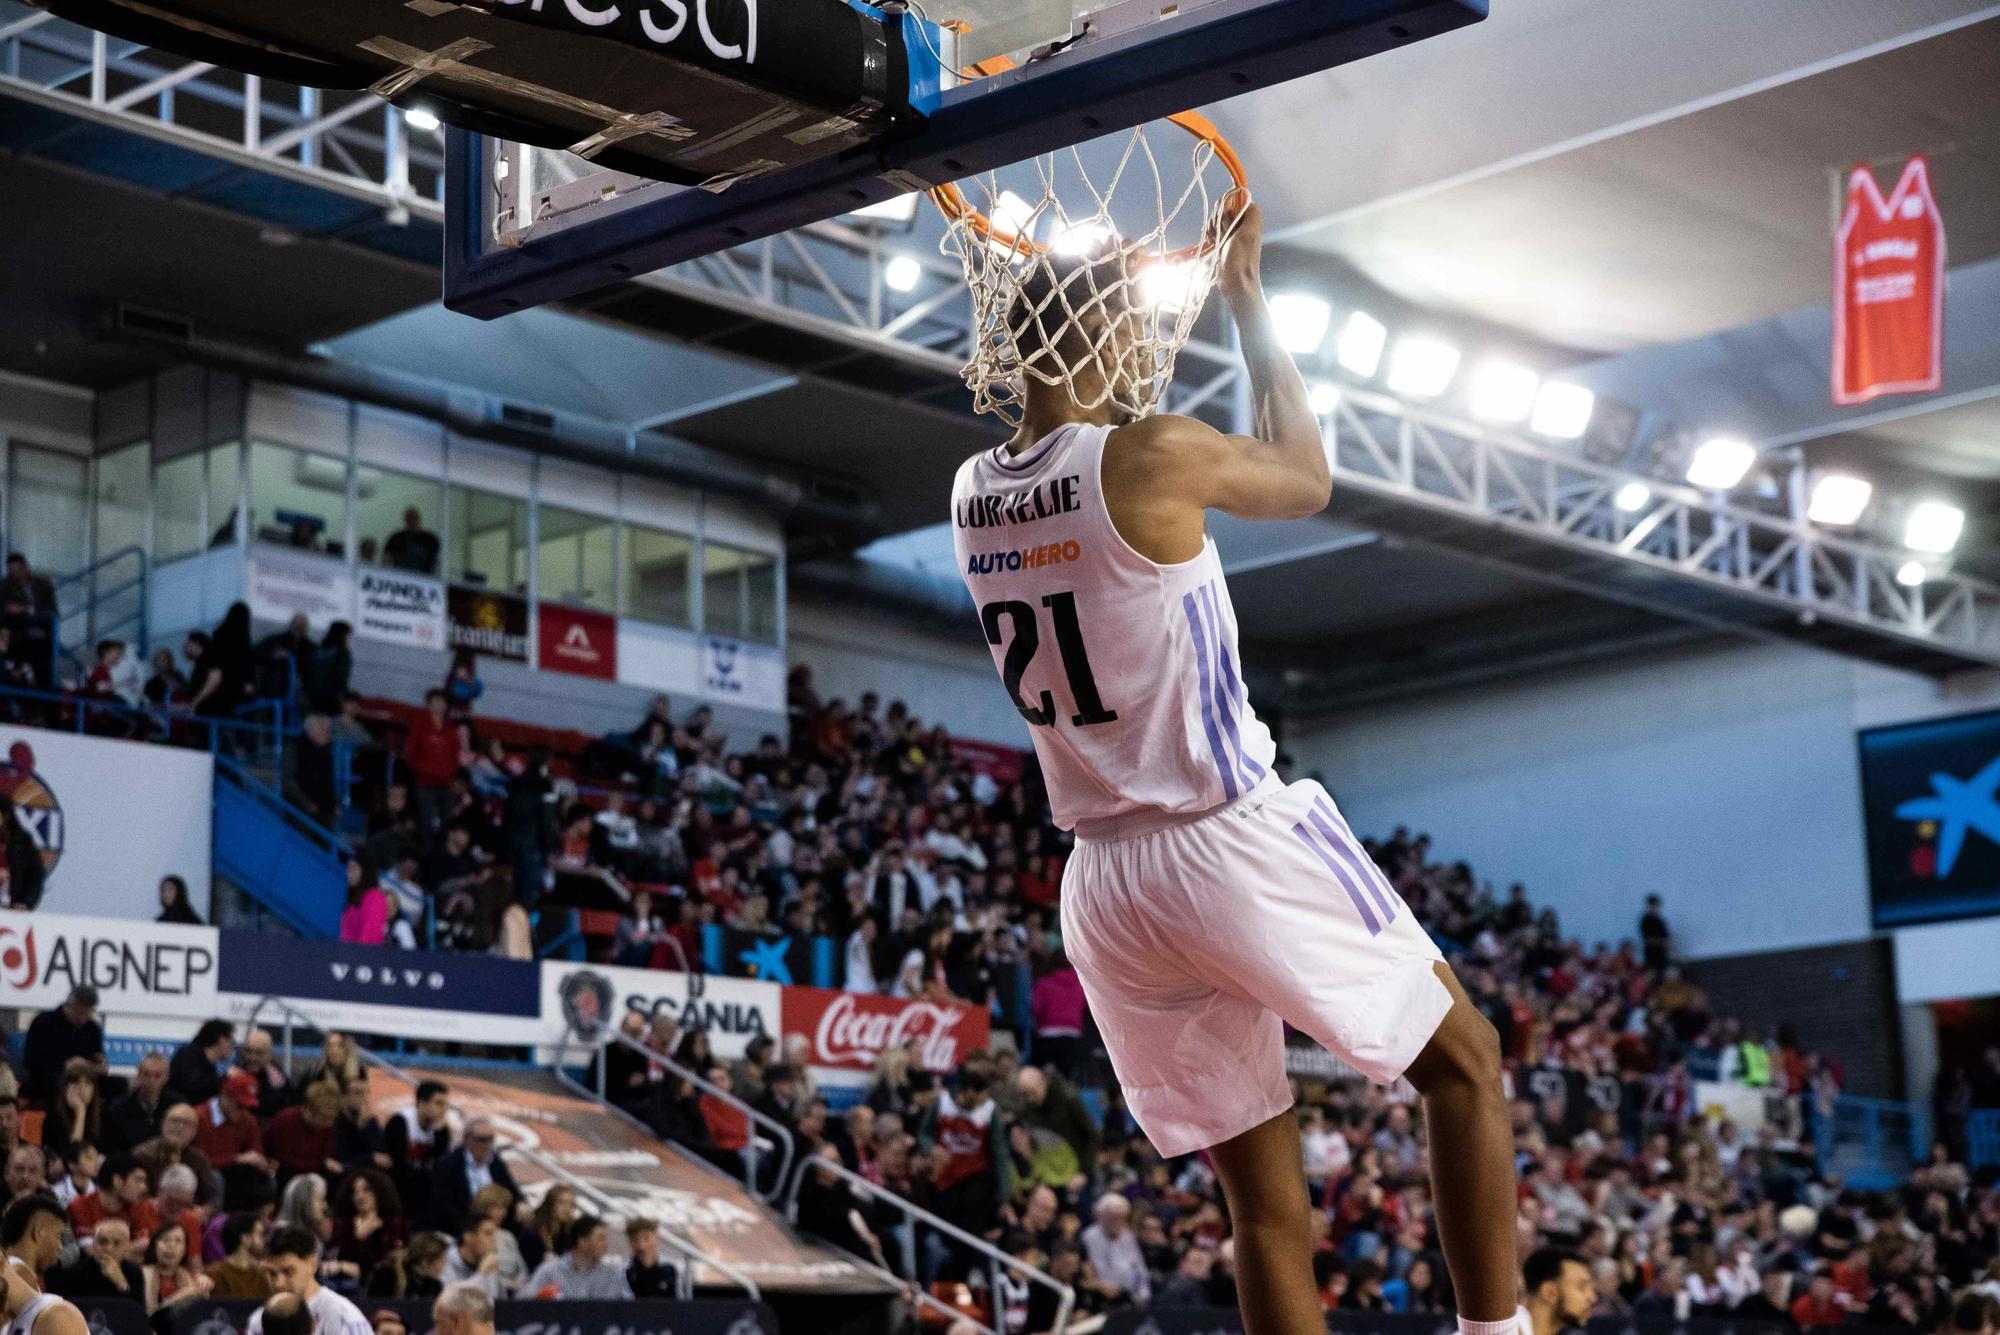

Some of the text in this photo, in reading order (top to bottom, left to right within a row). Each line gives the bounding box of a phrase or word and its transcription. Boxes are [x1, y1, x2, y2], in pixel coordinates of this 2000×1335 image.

[957, 475, 1081, 529] CORNELIE
[968, 538, 1081, 575] AUTOHERO
[981, 591, 1118, 728] 21
[43, 934, 213, 994] AIGNEP
[330, 962, 445, 991] VOLVO
[816, 994, 966, 1072] Coca-Cla
